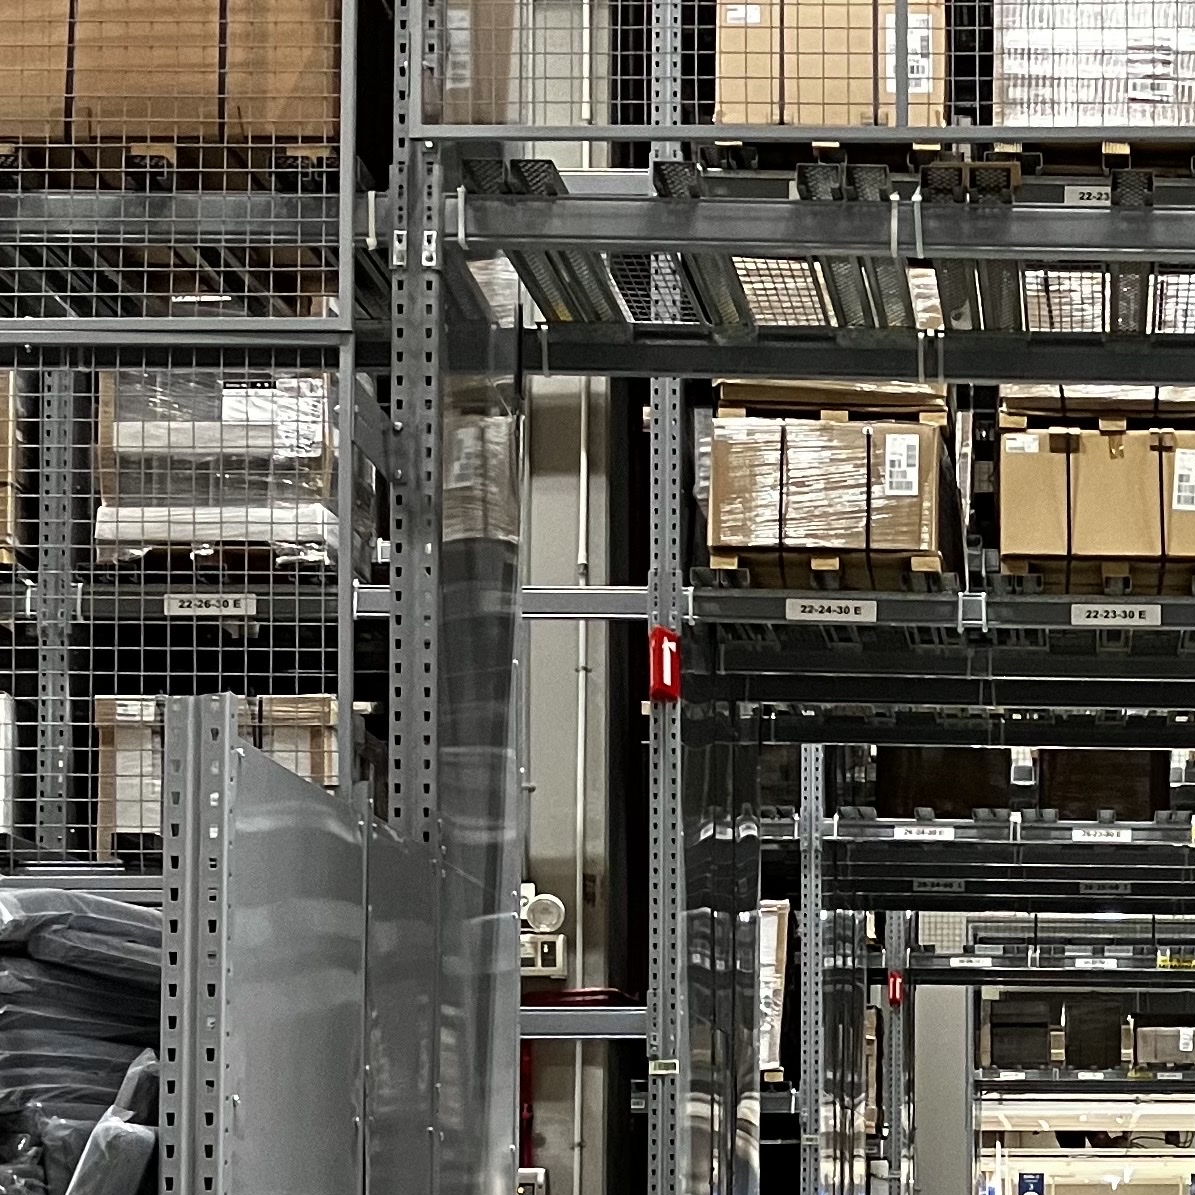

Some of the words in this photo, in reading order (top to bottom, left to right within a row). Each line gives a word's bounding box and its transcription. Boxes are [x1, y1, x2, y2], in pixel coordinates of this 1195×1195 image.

[800, 604, 850, 615] 22-24-30
[854, 606, 862, 616] E
[1085, 609, 1135, 619] 22-23-30
[1138, 610, 1147, 620] E
